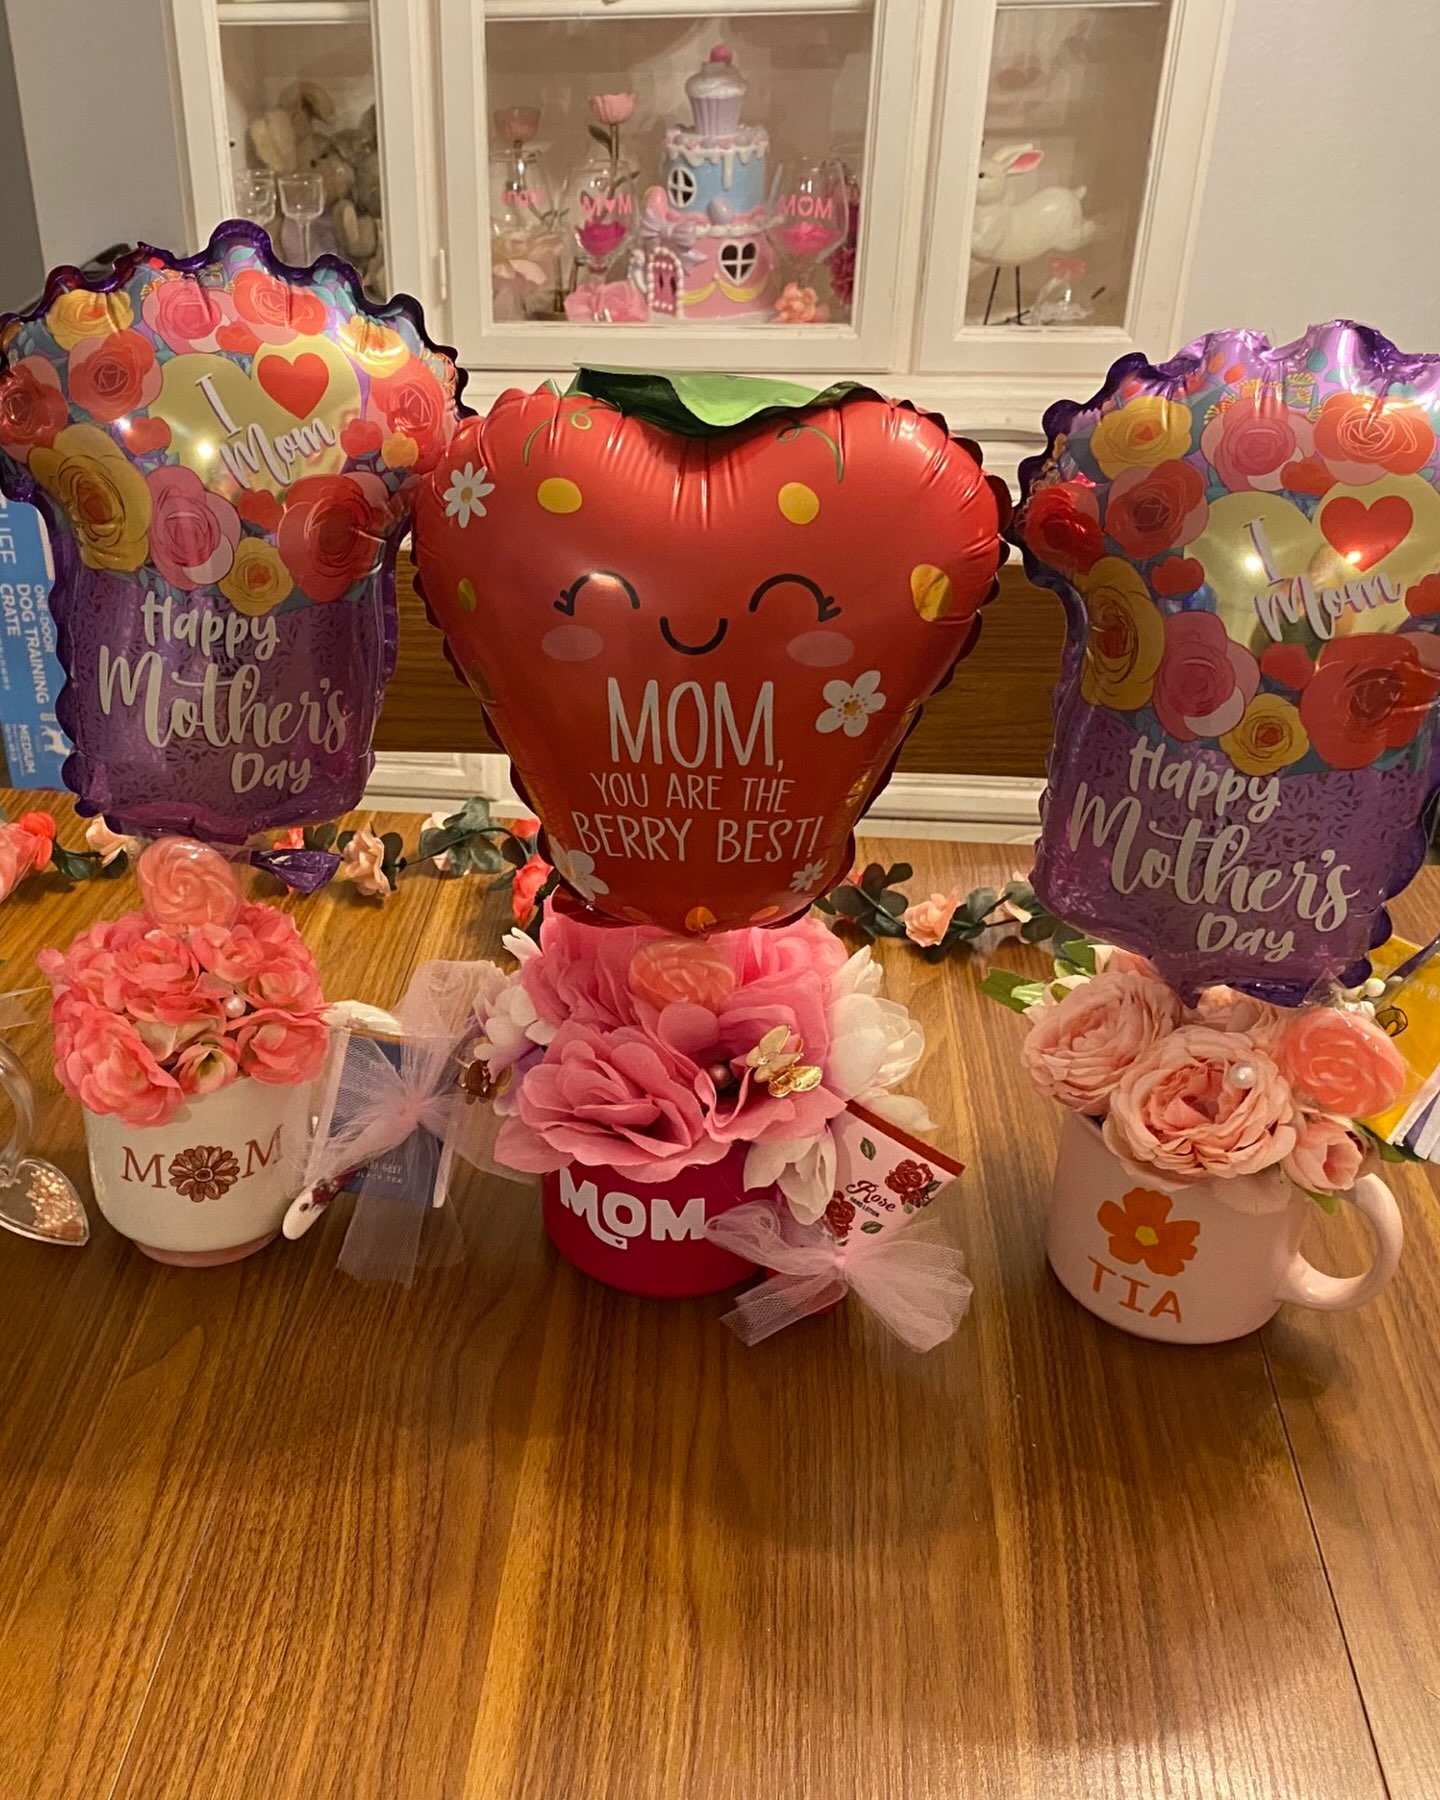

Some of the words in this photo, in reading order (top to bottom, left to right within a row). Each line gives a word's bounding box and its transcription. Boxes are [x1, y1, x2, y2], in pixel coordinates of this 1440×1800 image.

[778, 193, 833, 219] MOM
[194, 372, 242, 438] I
[220, 416, 339, 490] Mom
[1243, 515, 1285, 584] I
[0, 583, 21, 636] CRATE
[16, 584, 35, 623] DOG
[34, 584, 54, 653] ONE-DOOR
[140, 590, 280, 662] Happy
[1254, 570, 1402, 642] Mom
[25, 626, 50, 704] TRAINING
[99, 644, 353, 754] Mother's
[19, 724, 36, 773] MEDIUM
[607, 677, 785, 772] MOM,
[231, 751, 312, 795] Day
[590, 772, 649, 808] YOU
[666, 773, 723, 811] ARE
[742, 777, 796, 813] THE
[1128, 735, 1281, 823] Happy
[571, 811, 693, 862] BERRY
[717, 816, 824, 864] BEST!
[1069, 781, 1362, 933] Mother's
[1196, 912, 1296, 964] Day
[559, 1165, 706, 1250] MOM
[845, 1180, 896, 1212] Rose
[1087, 1255, 1182, 1324] TIA
